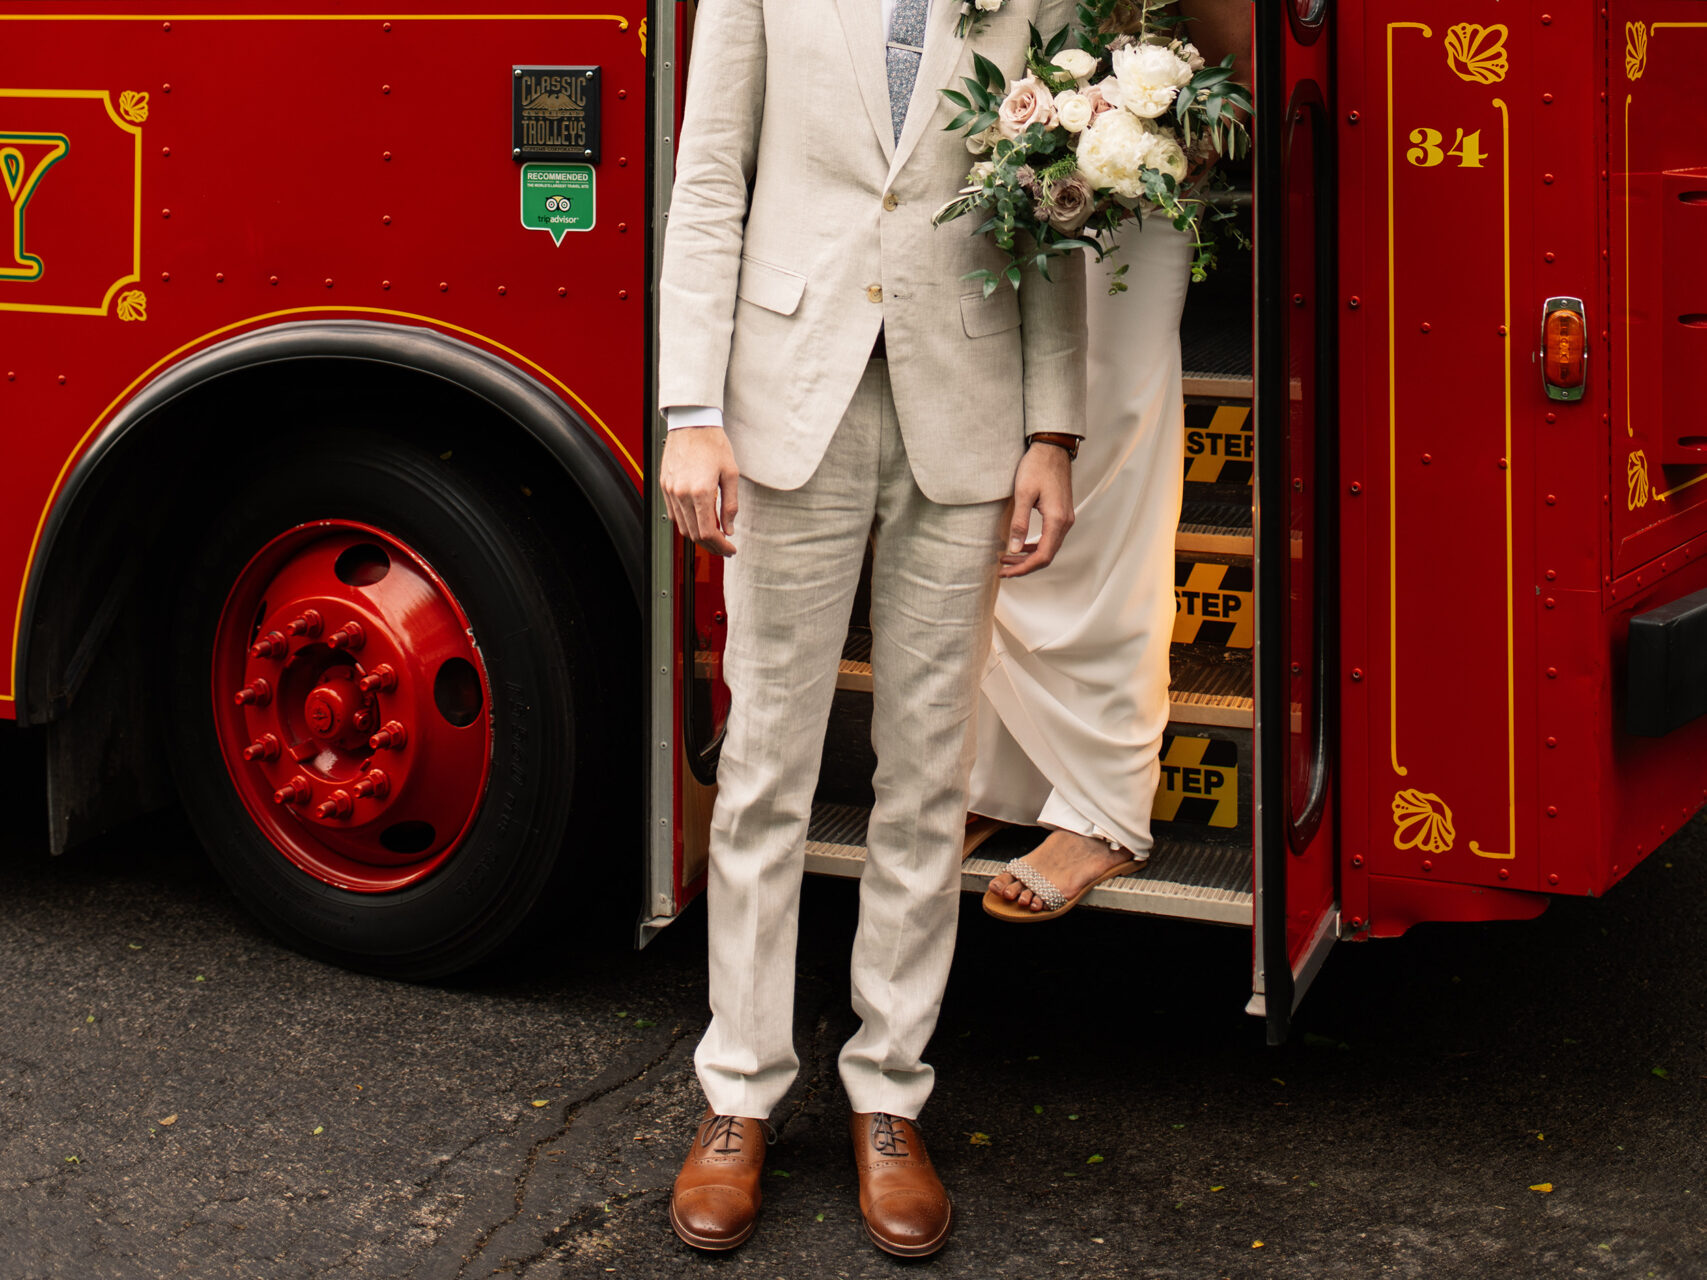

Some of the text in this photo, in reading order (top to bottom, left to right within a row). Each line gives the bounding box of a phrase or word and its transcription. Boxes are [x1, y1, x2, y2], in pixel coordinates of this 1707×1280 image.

[521, 75, 586, 106] CLASSIC
[521, 120, 586, 145] TROLLEYS
[1406, 127, 1488, 167] 34
[527, 172, 588, 181] RECOMMENDED
[1160, 765, 1224, 795] TEP
